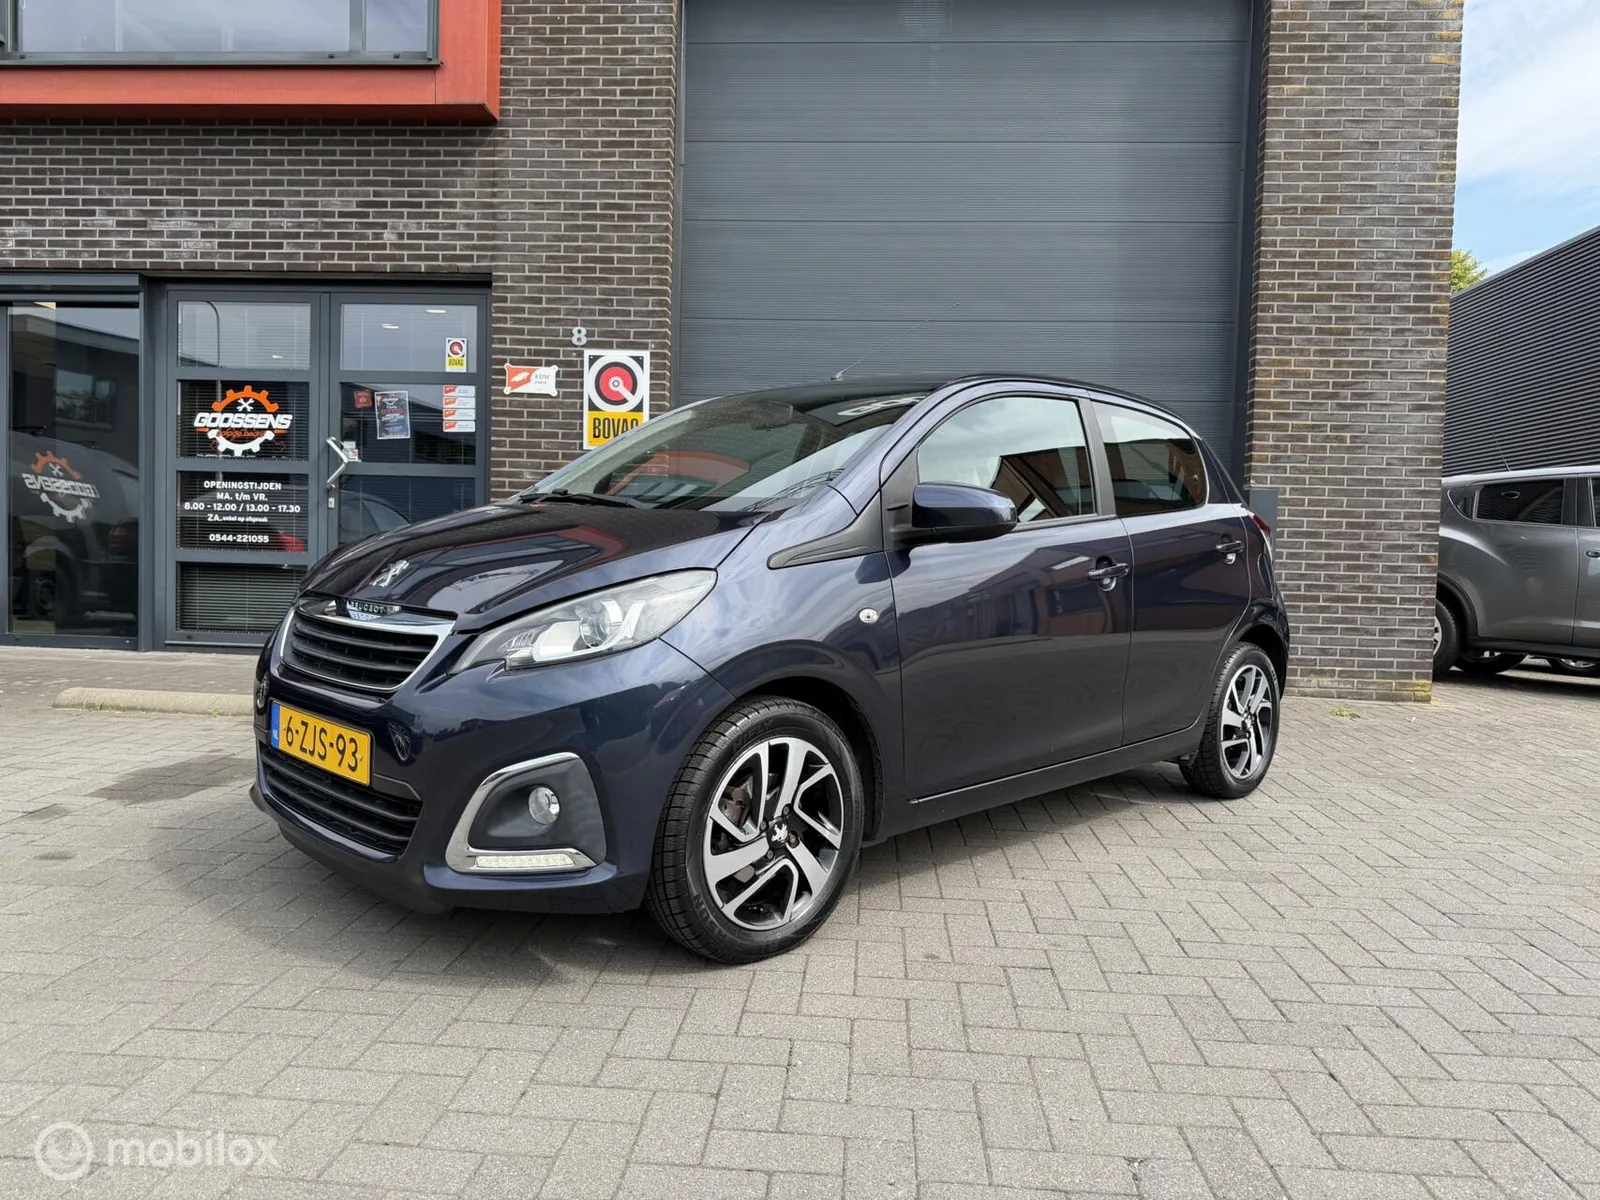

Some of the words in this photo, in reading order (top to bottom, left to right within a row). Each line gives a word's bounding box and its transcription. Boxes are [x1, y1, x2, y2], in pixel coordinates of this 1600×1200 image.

[571, 326, 587, 346] 8
[193, 412, 293, 429] GOOSSENS
[203, 480, 282, 490] OPENINGSTIJDEN
[216, 492, 233, 500] MA.
[235, 492, 251, 501] t/m
[252, 493, 268, 501] VR.
[184, 502, 205, 510] 8.00
[213, 503, 237, 511] 12.00
[246, 504, 270, 512] 13.00
[278, 505, 301, 513] 17.30
[207, 513, 222, 522] ZA.
[209, 534, 269, 543] 0544-221055
[284, 715, 359, 773] 6-ZJS-93
